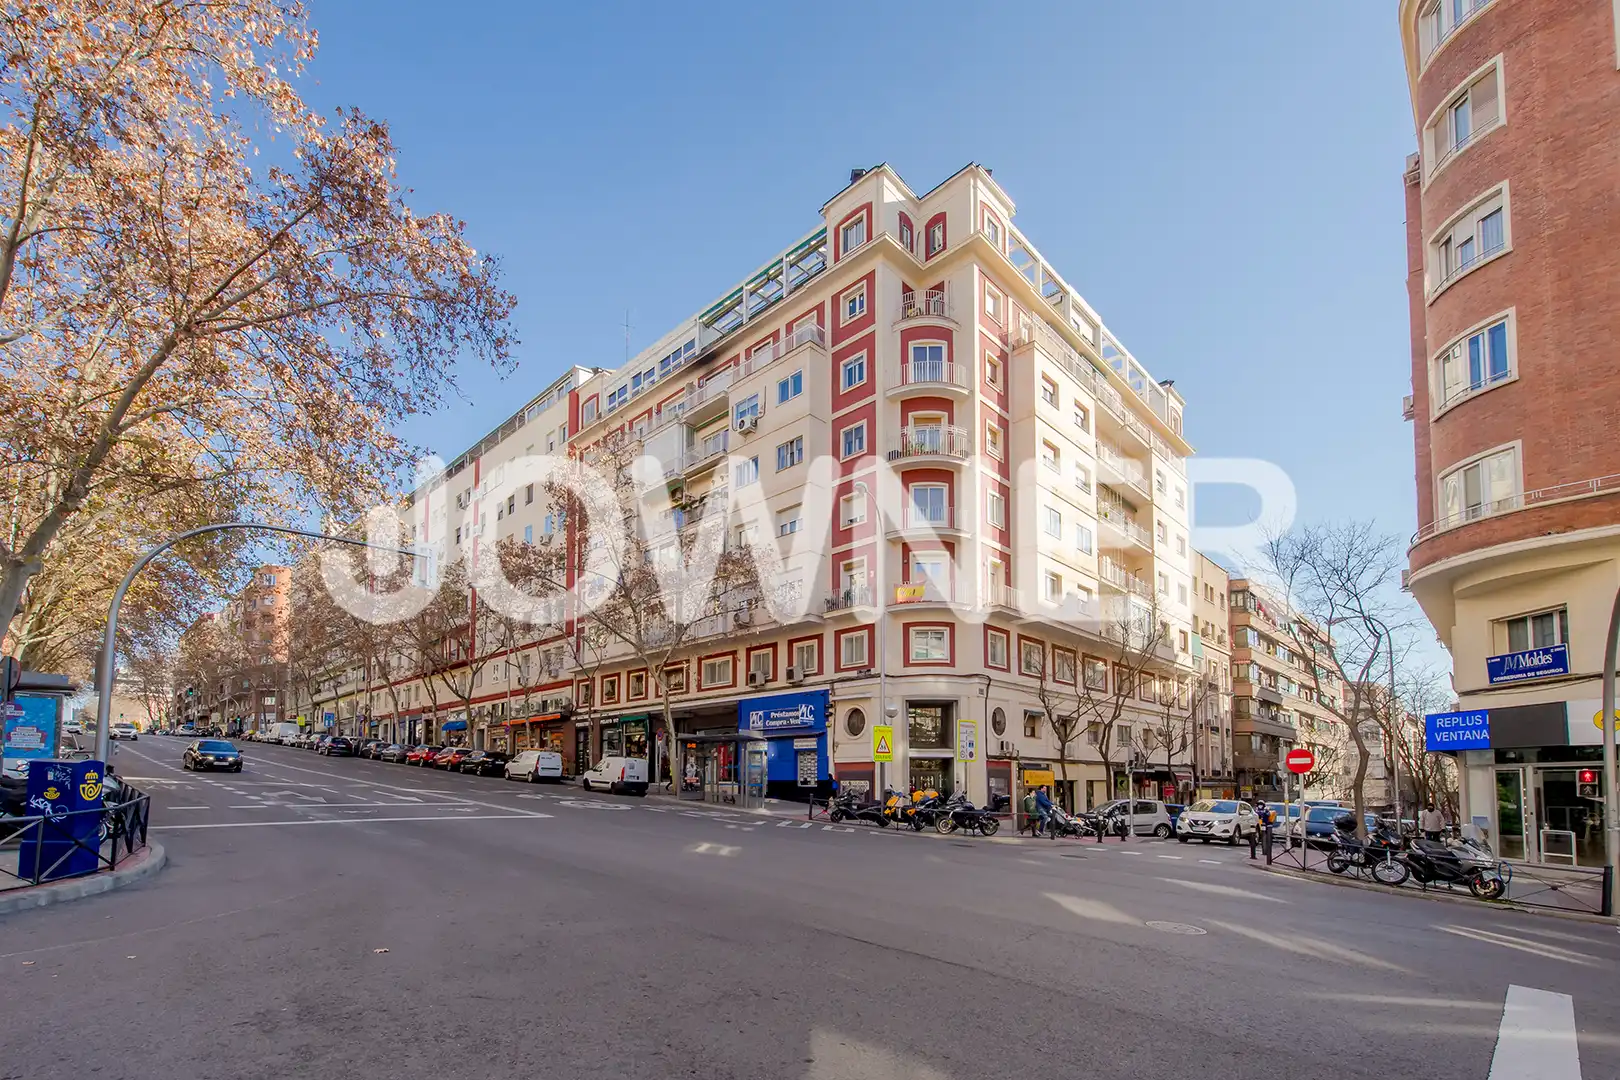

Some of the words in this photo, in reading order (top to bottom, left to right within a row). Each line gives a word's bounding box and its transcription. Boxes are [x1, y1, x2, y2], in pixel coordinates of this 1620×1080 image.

[1519, 651, 1553, 668] Moldes
[1536, 667, 1564, 676] SEGUROS
[1436, 714, 1483, 728] REPLUS
[1434, 728, 1490, 742] VENTANA
